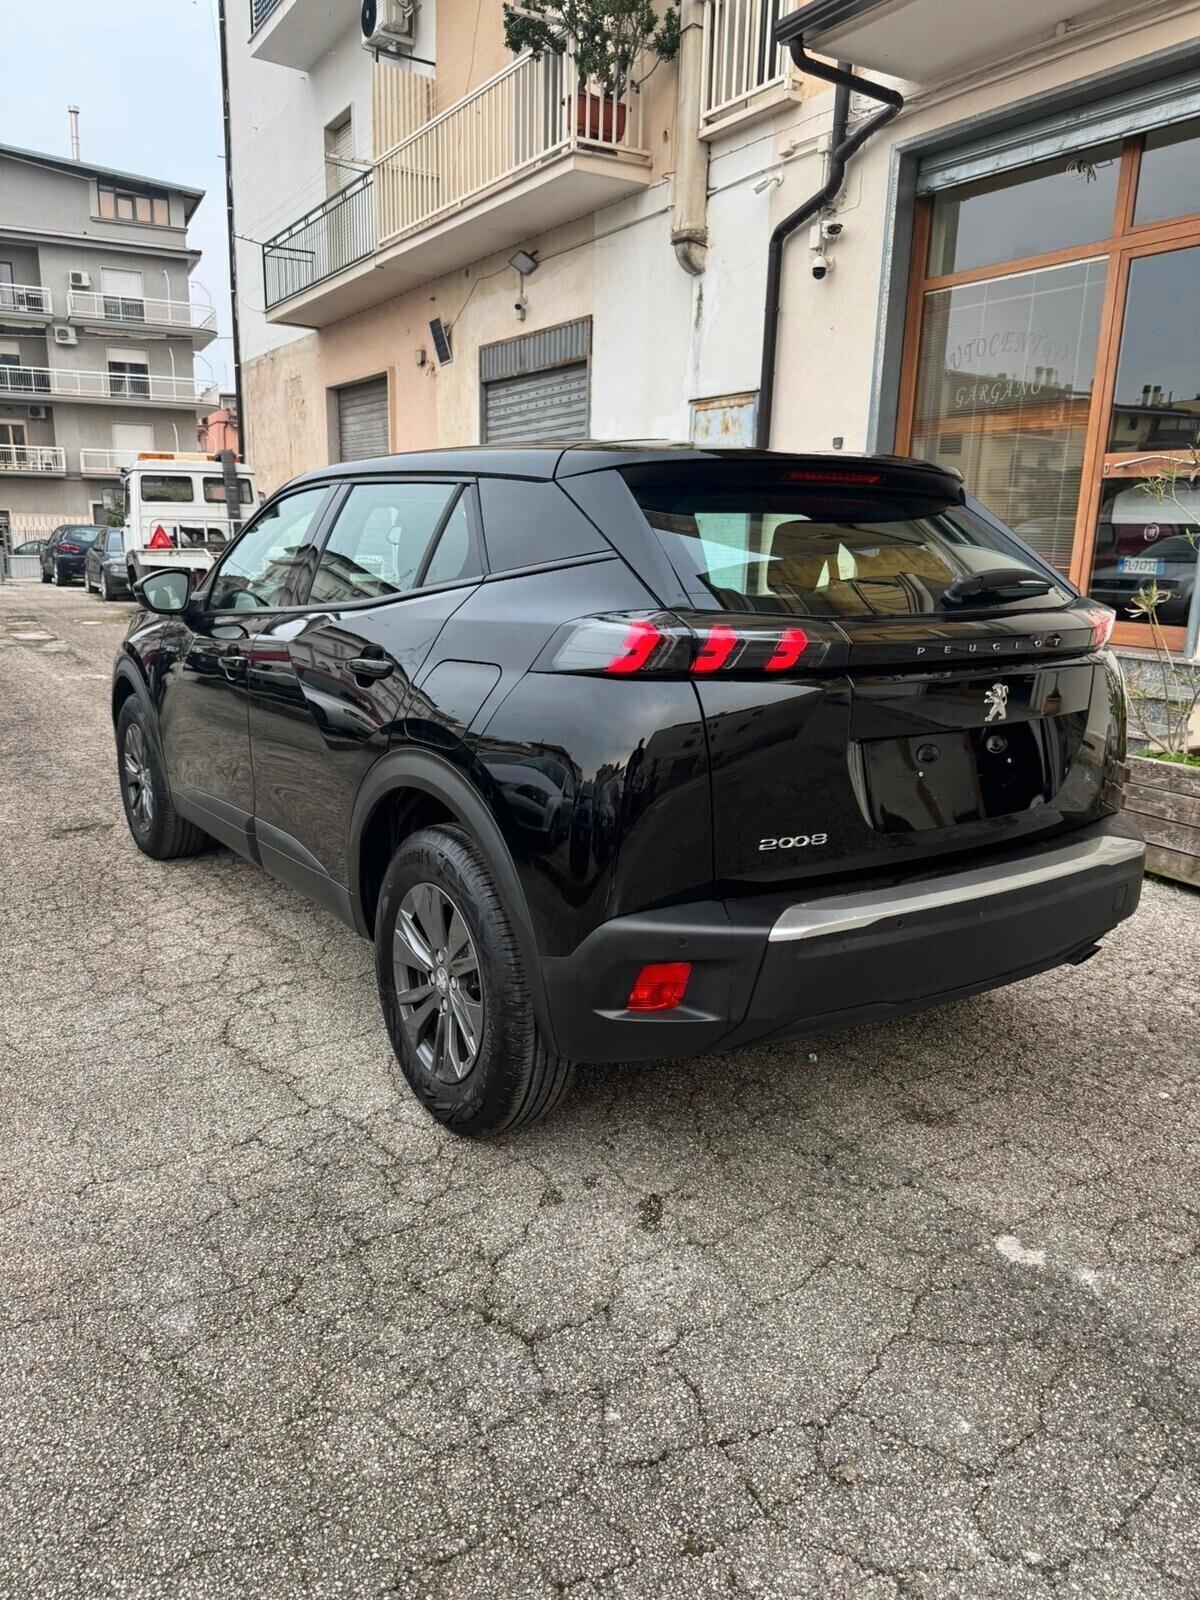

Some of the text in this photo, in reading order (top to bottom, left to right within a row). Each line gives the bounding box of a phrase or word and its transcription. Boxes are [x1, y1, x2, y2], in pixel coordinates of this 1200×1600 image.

[954, 380, 1043, 409] GARGANO
[916, 637, 1061, 656] PEUGEOT
[758, 833, 828, 851] 2008
